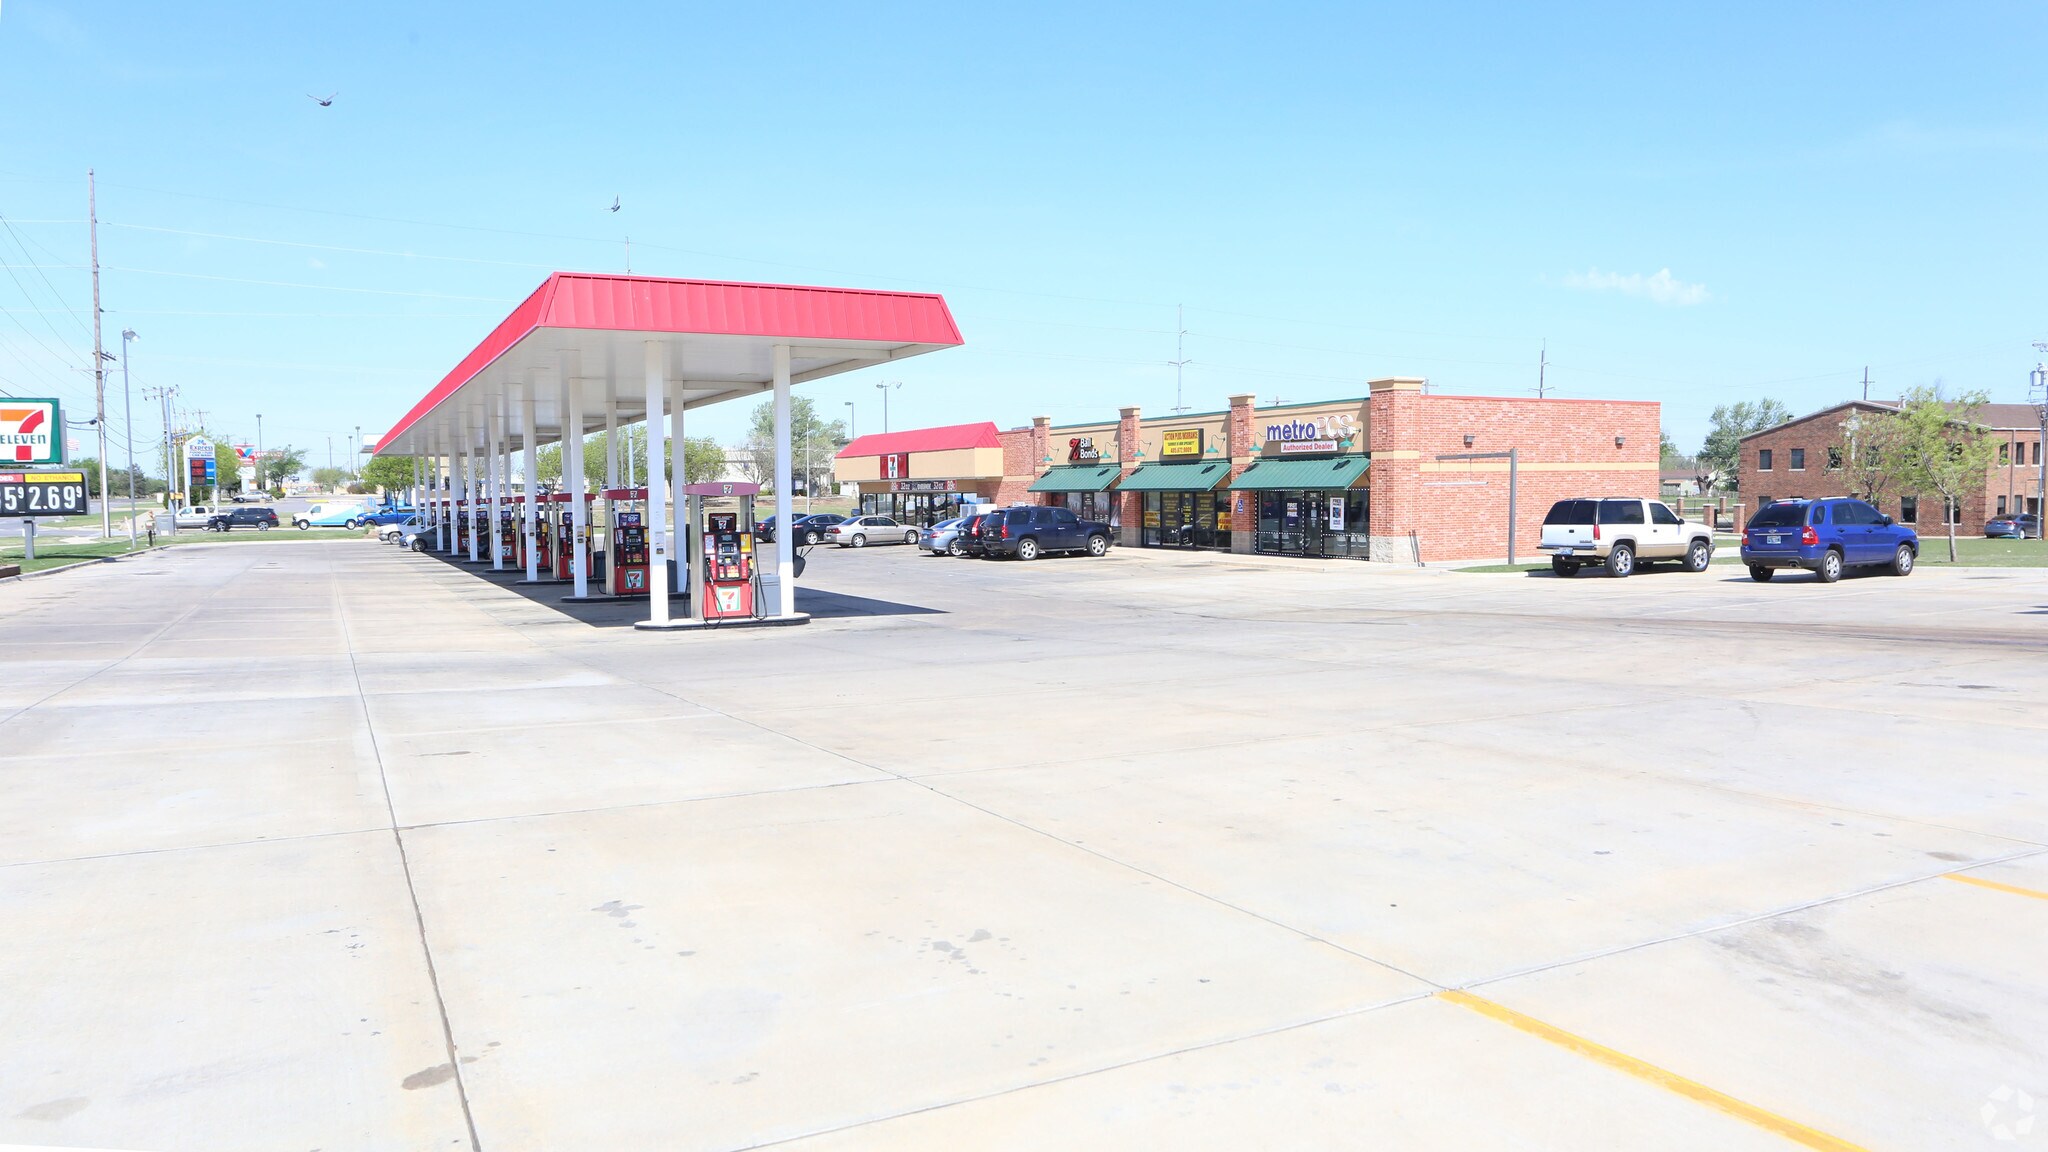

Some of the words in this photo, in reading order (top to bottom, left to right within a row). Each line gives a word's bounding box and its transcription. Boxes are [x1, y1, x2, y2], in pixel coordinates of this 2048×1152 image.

[1266, 415, 1354, 441] metroPCS
[1080, 437, 1092, 447] Bail
[1283, 443, 1312, 451] Authorized
[1314, 442, 1333, 450] Dealer
[1080, 448, 1098, 459] Bonds
